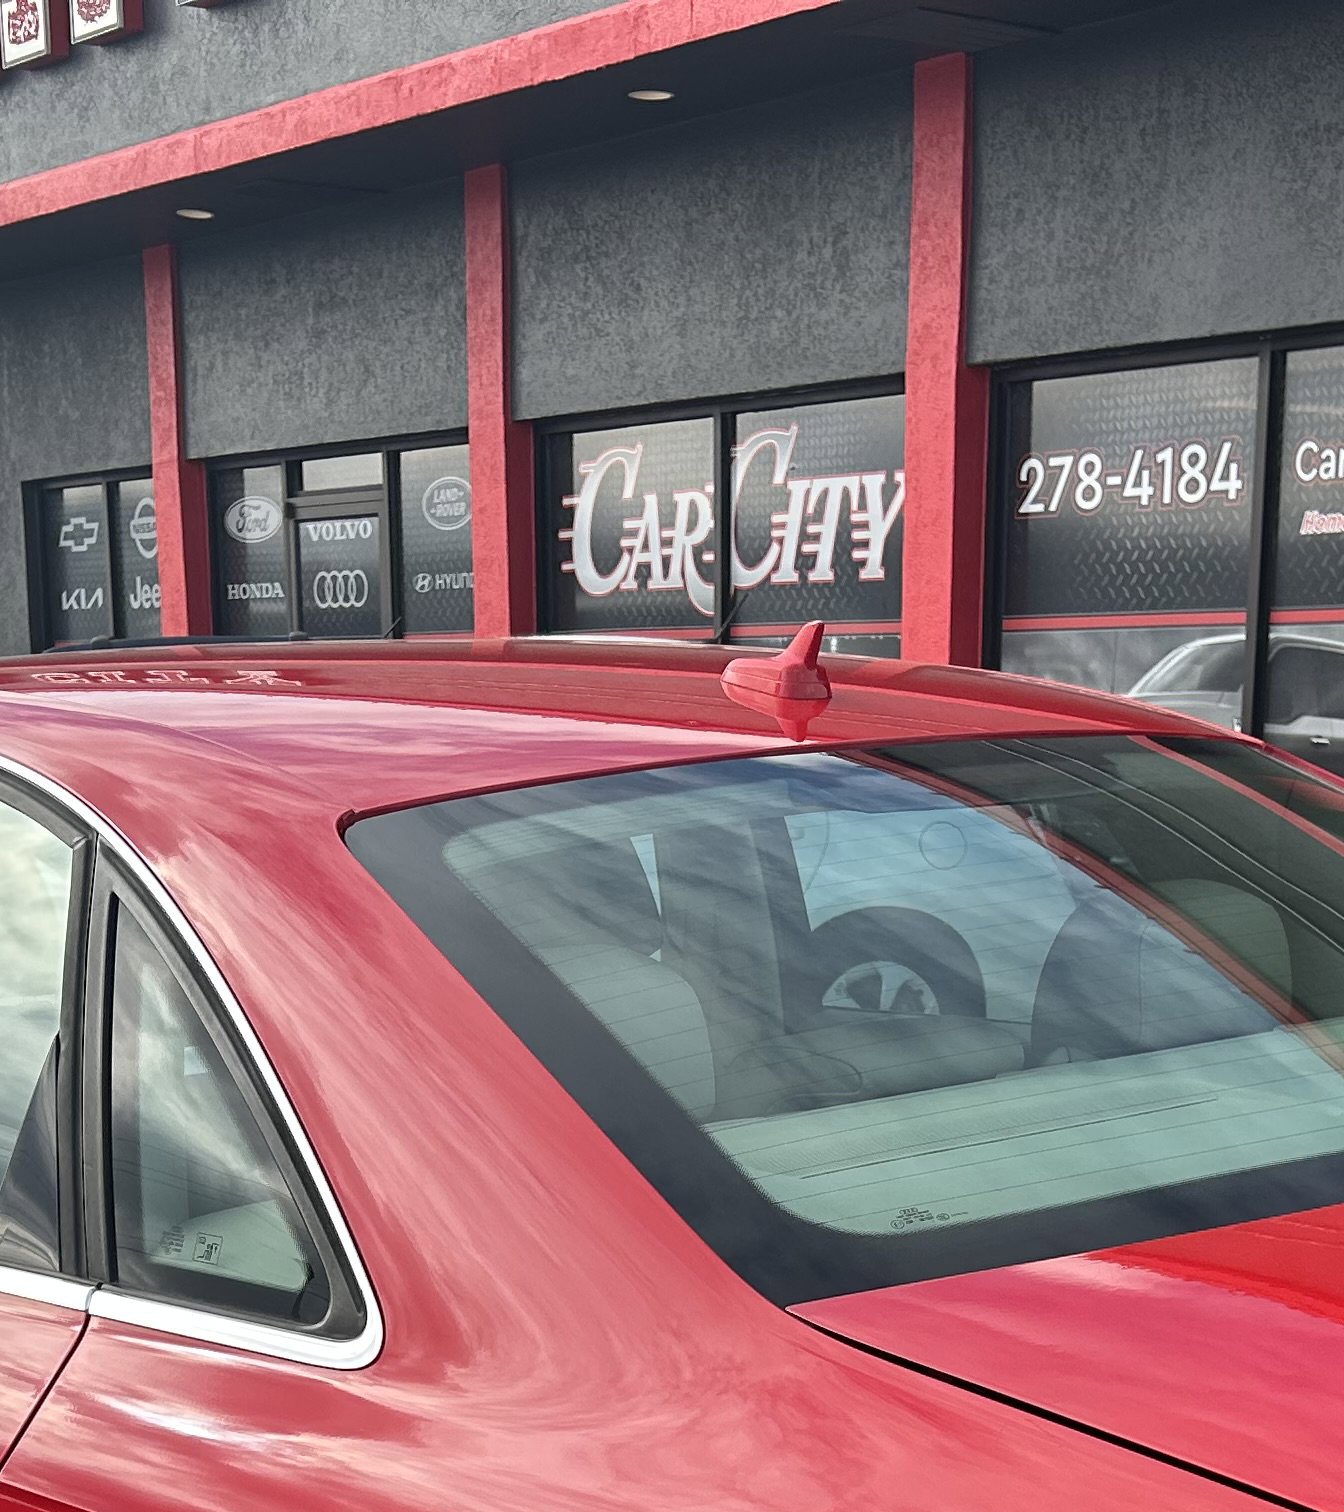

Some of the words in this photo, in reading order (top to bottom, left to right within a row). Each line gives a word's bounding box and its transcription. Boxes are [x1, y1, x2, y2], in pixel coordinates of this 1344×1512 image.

[1019, 441, 1243, 514] 278-4184
[236, 503, 272, 534] Ford
[307, 520, 373, 542] VOLVO
[227, 582, 285, 600] HONDA
[435, 573, 473, 589] HYUN
[61, 587, 104, 610] KIA
[129, 576, 162, 610] Jee
